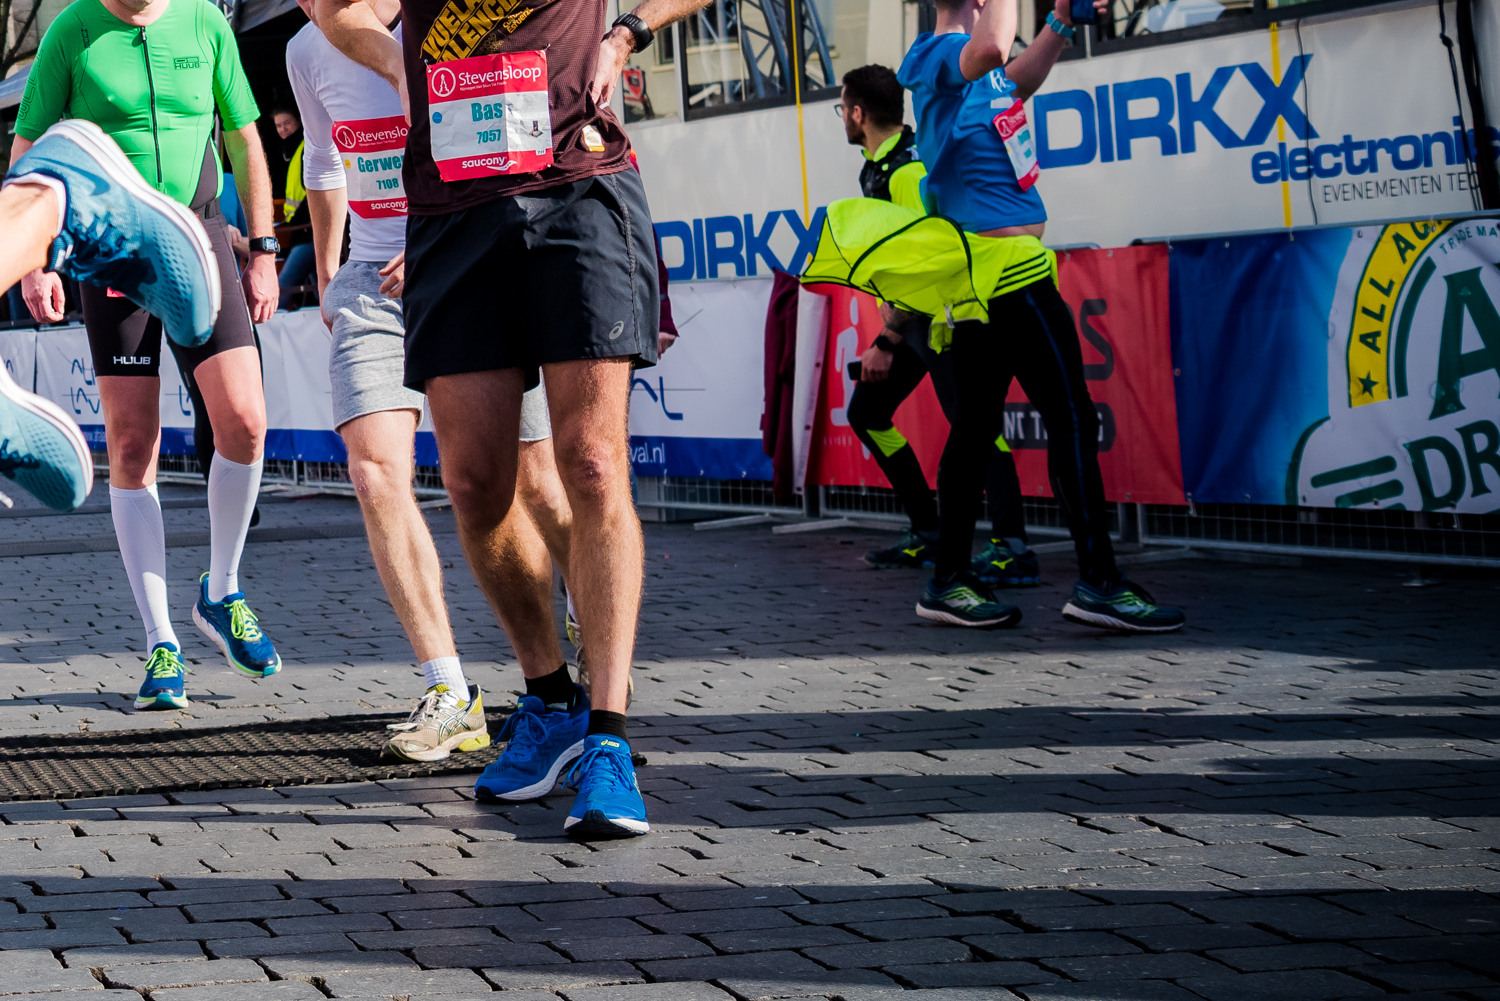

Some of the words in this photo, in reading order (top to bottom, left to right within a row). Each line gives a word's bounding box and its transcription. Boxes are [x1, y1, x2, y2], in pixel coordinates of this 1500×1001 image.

[174, 62, 200, 70] HUUB
[458, 66, 542, 86] Stevensloop
[470, 102, 503, 122] Bas
[1033, 53, 1320, 169] DIRKX
[476, 129, 502, 144] 7057
[1251, 115, 1500, 185] electroni
[462, 156, 505, 169] saucony
[376, 178, 399, 190] 7108
[1323, 175, 1442, 204] EVENEMENTEN
[370, 201, 406, 210] saucony
[653, 206, 827, 281] DIRKX
[1439, 226, 1472, 255] TRADE
[1358, 277, 1395, 355] ALL
[113, 356, 151, 365] HUUB
